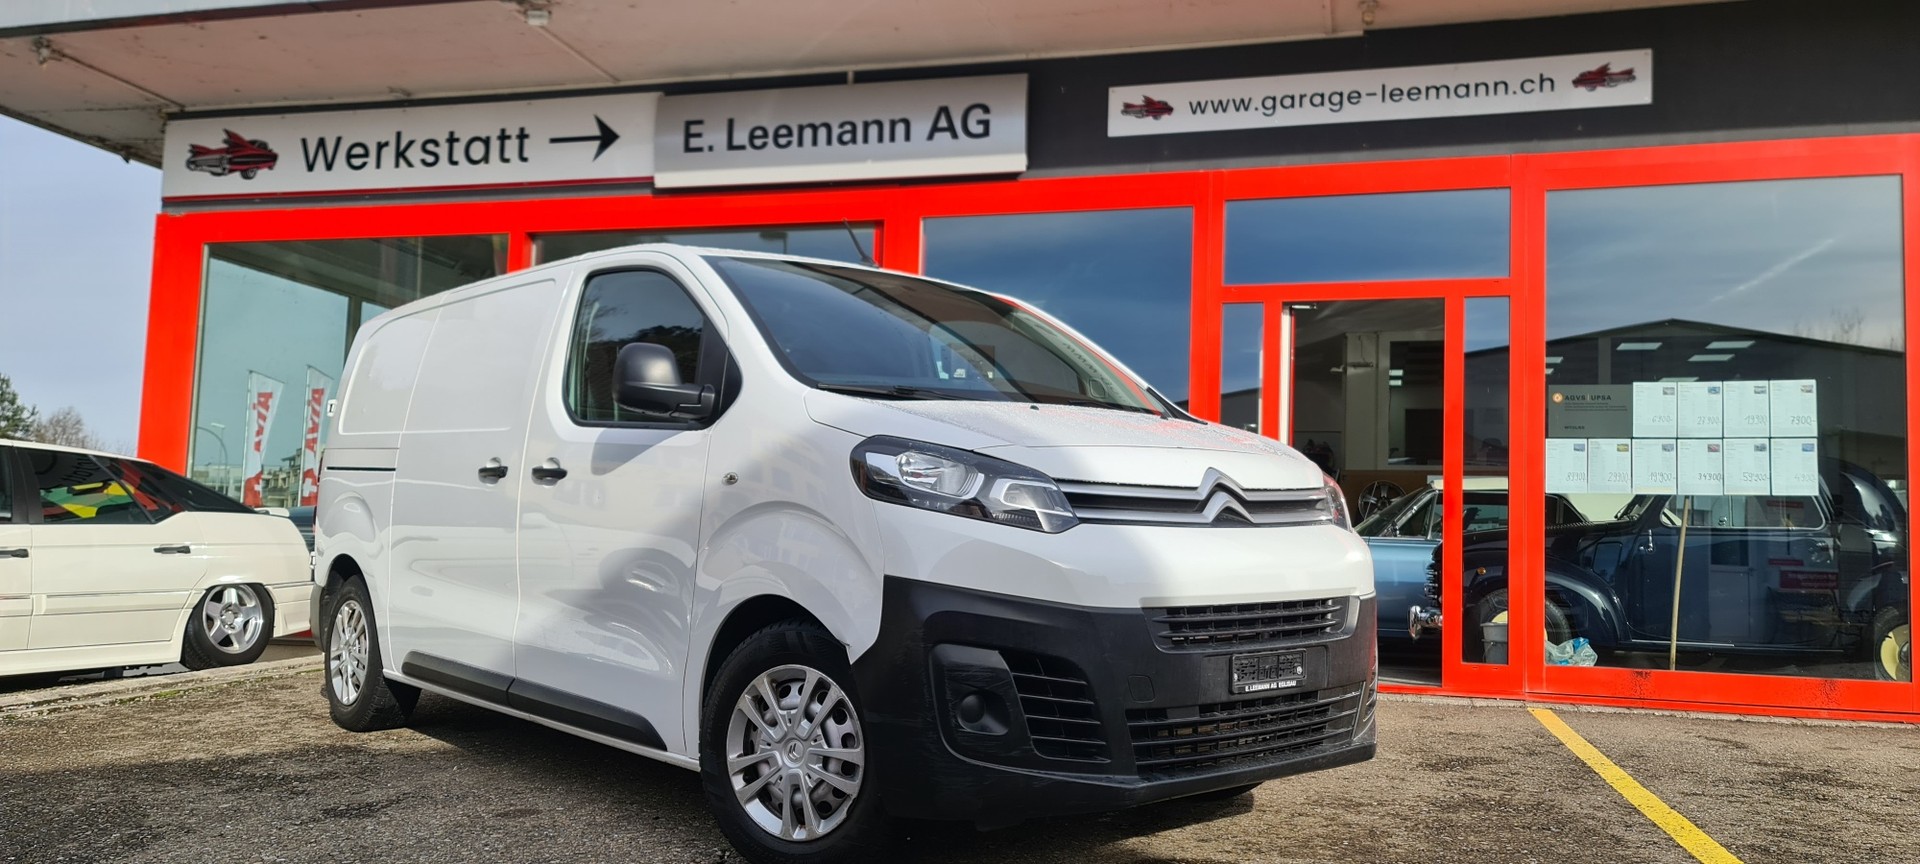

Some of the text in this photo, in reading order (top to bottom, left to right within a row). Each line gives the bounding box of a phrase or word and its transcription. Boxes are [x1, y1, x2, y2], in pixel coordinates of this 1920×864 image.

[1188, 72, 1556, 117] www.garage-leemann.ch
[301, 126, 530, 173] Werkstatt
[683, 103, 992, 154] E. Leemann AG
